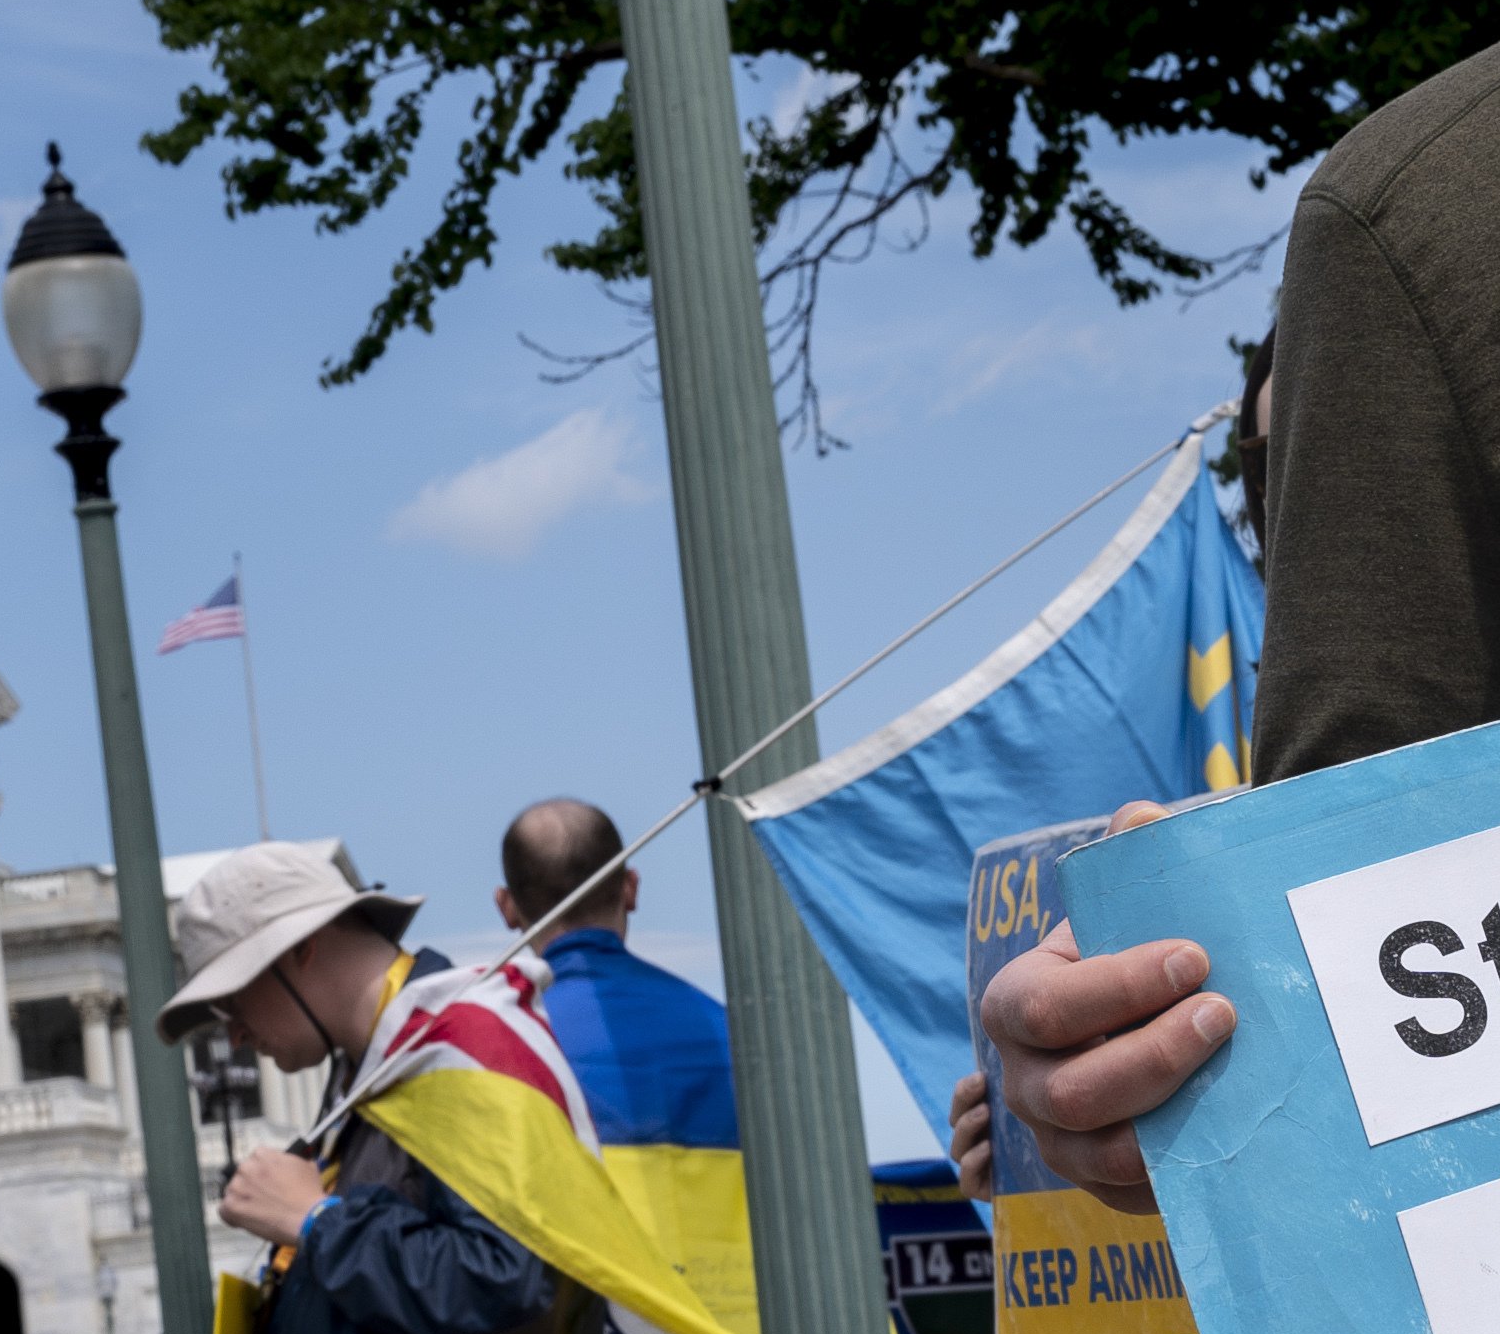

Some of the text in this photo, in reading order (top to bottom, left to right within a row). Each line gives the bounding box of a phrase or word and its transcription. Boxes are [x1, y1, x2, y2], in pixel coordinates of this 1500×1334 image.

[976, 854, 1051, 943] USA,
[904, 1242, 953, 1285] 14
[1002, 1248, 1077, 1308] KEEP
